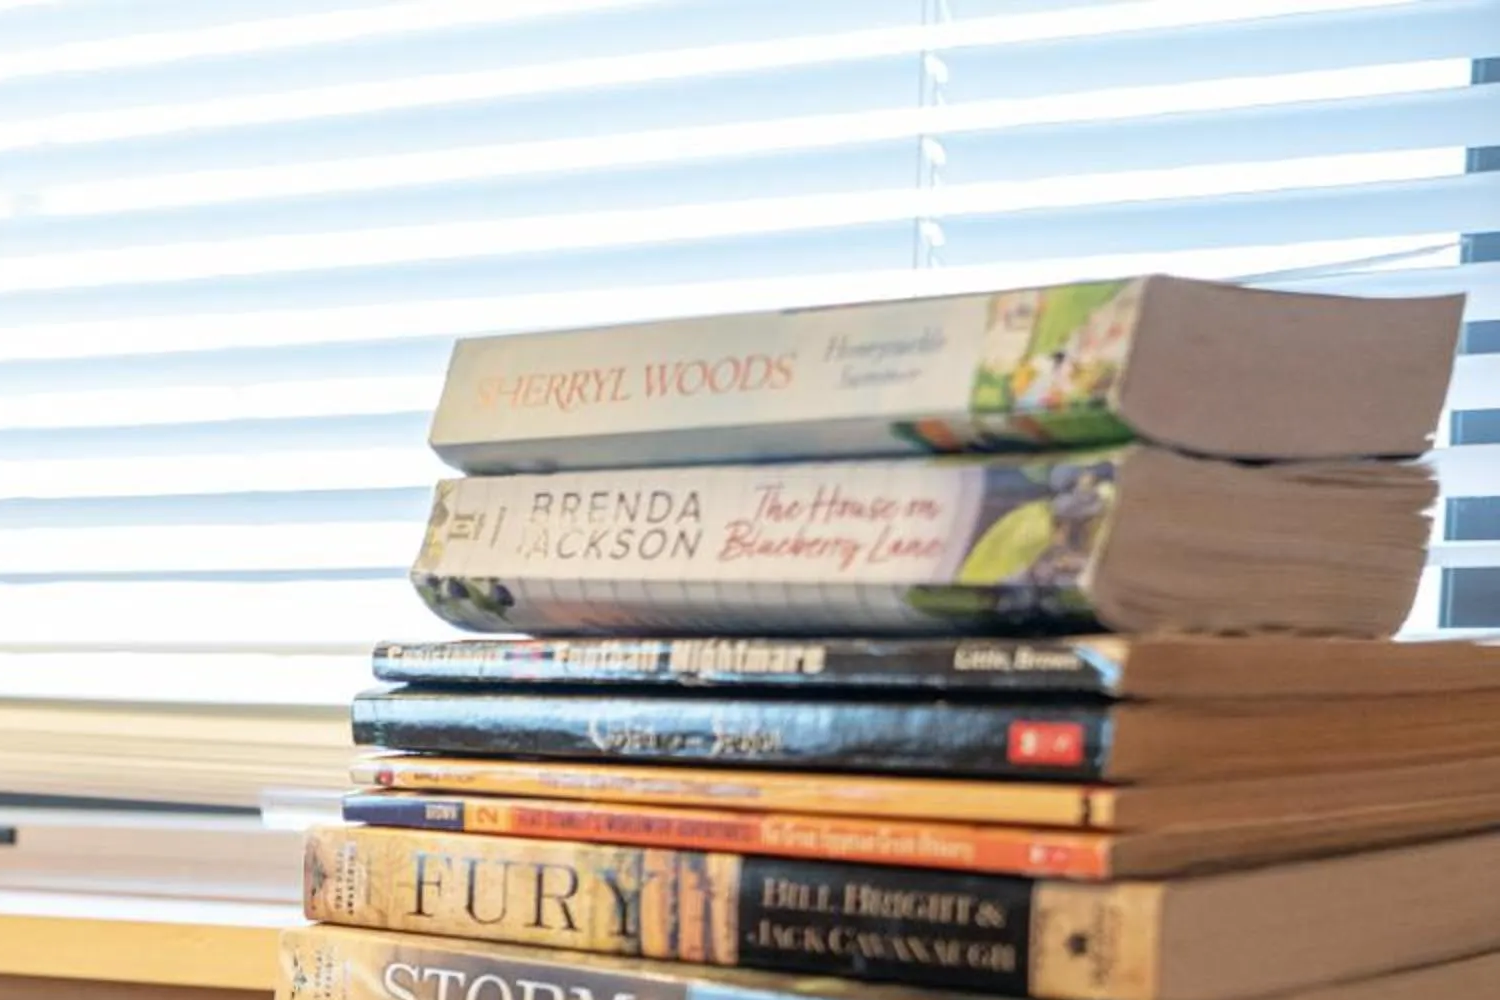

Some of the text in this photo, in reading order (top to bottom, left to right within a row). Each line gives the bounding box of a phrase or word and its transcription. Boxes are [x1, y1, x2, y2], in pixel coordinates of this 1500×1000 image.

[475, 350, 796, 413] SHERRYL WOODS
[531, 489, 702, 526] BRENDA
[753, 484, 942, 524] The House on
[716, 520, 944, 572] Blueberry Lane
[406, 850, 658, 937] FURY
[974, 898, 1006, 928] &
